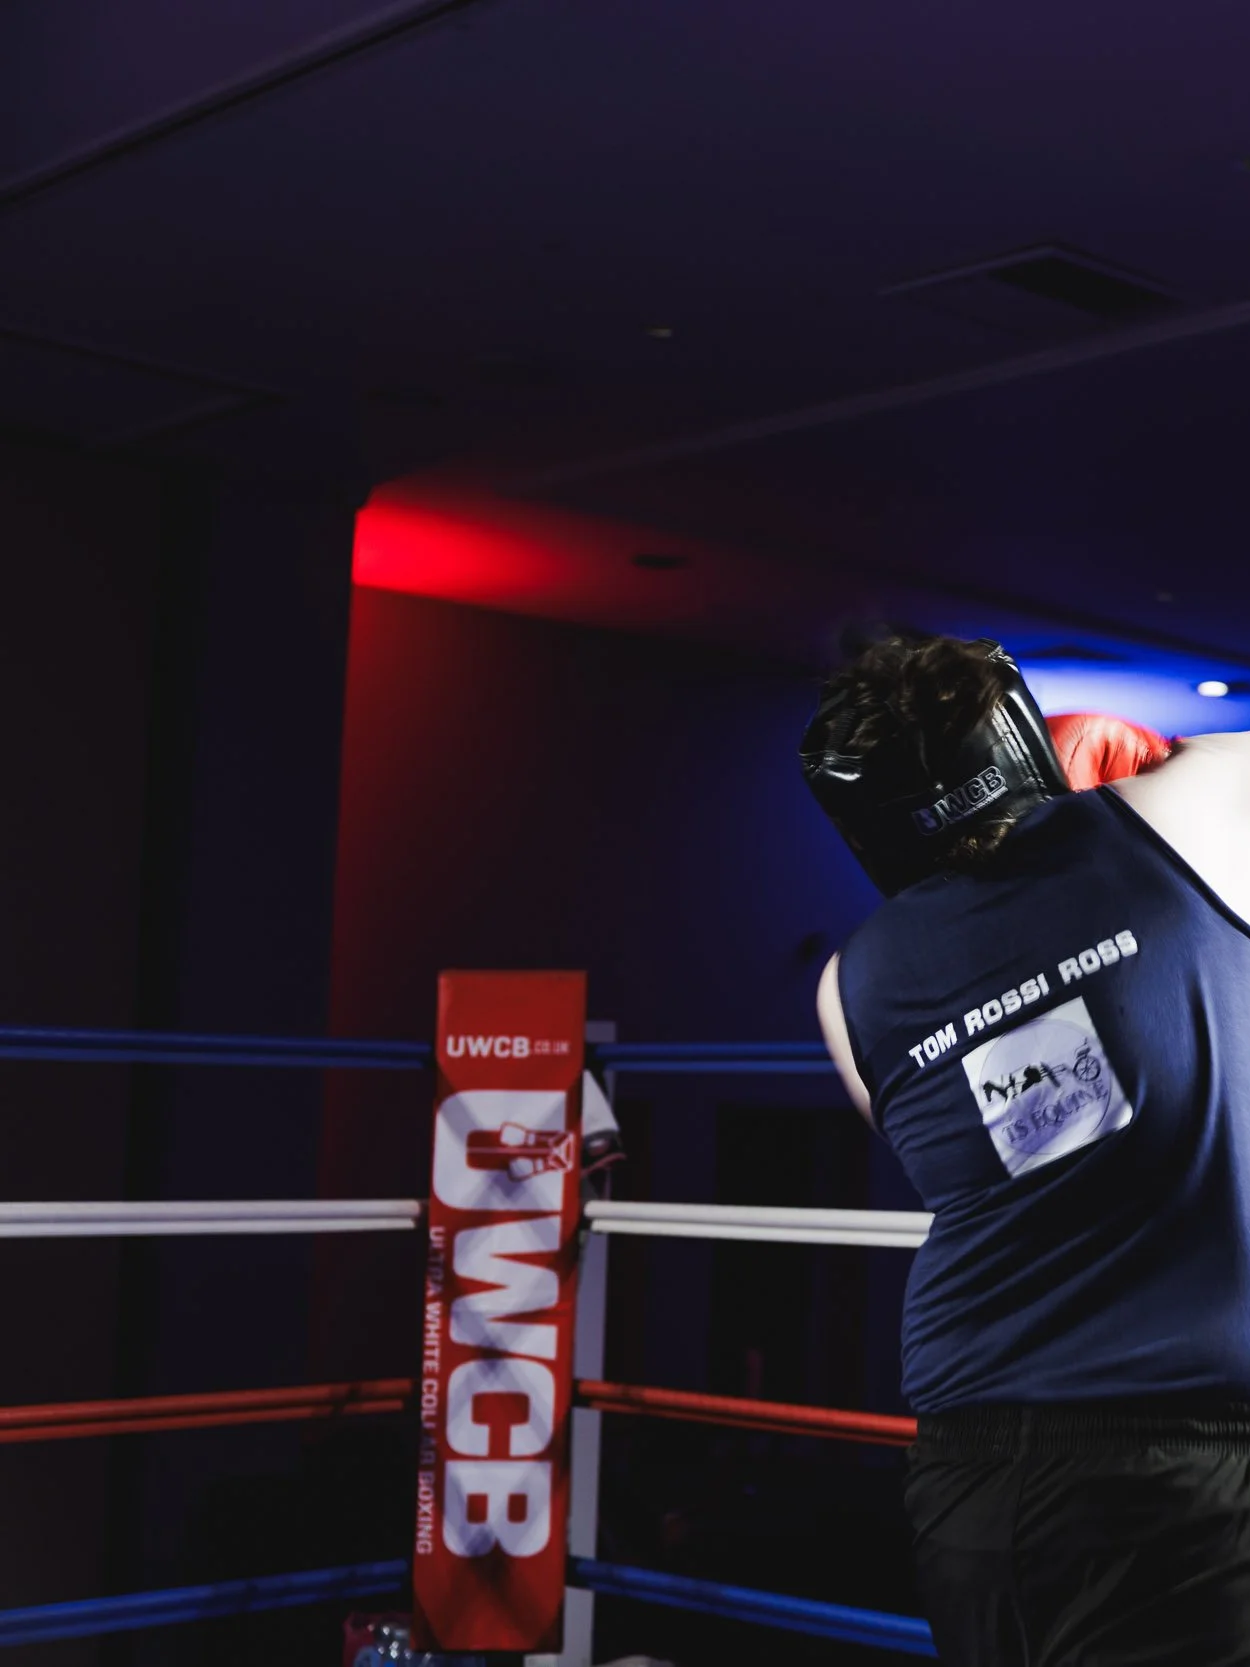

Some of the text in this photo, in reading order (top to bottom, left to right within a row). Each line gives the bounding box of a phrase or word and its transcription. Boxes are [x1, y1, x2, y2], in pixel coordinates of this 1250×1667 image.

[911, 765, 1007, 835] UWCB
[908, 929, 1138, 1068] TOM ROSSI ROSS
[425, 1226, 445, 1297] ULTRA
[422, 1302, 442, 1374] WHITE
[433, 1090, 568, 1558] UWCB
[415, 1471, 435, 1555] BOXING
